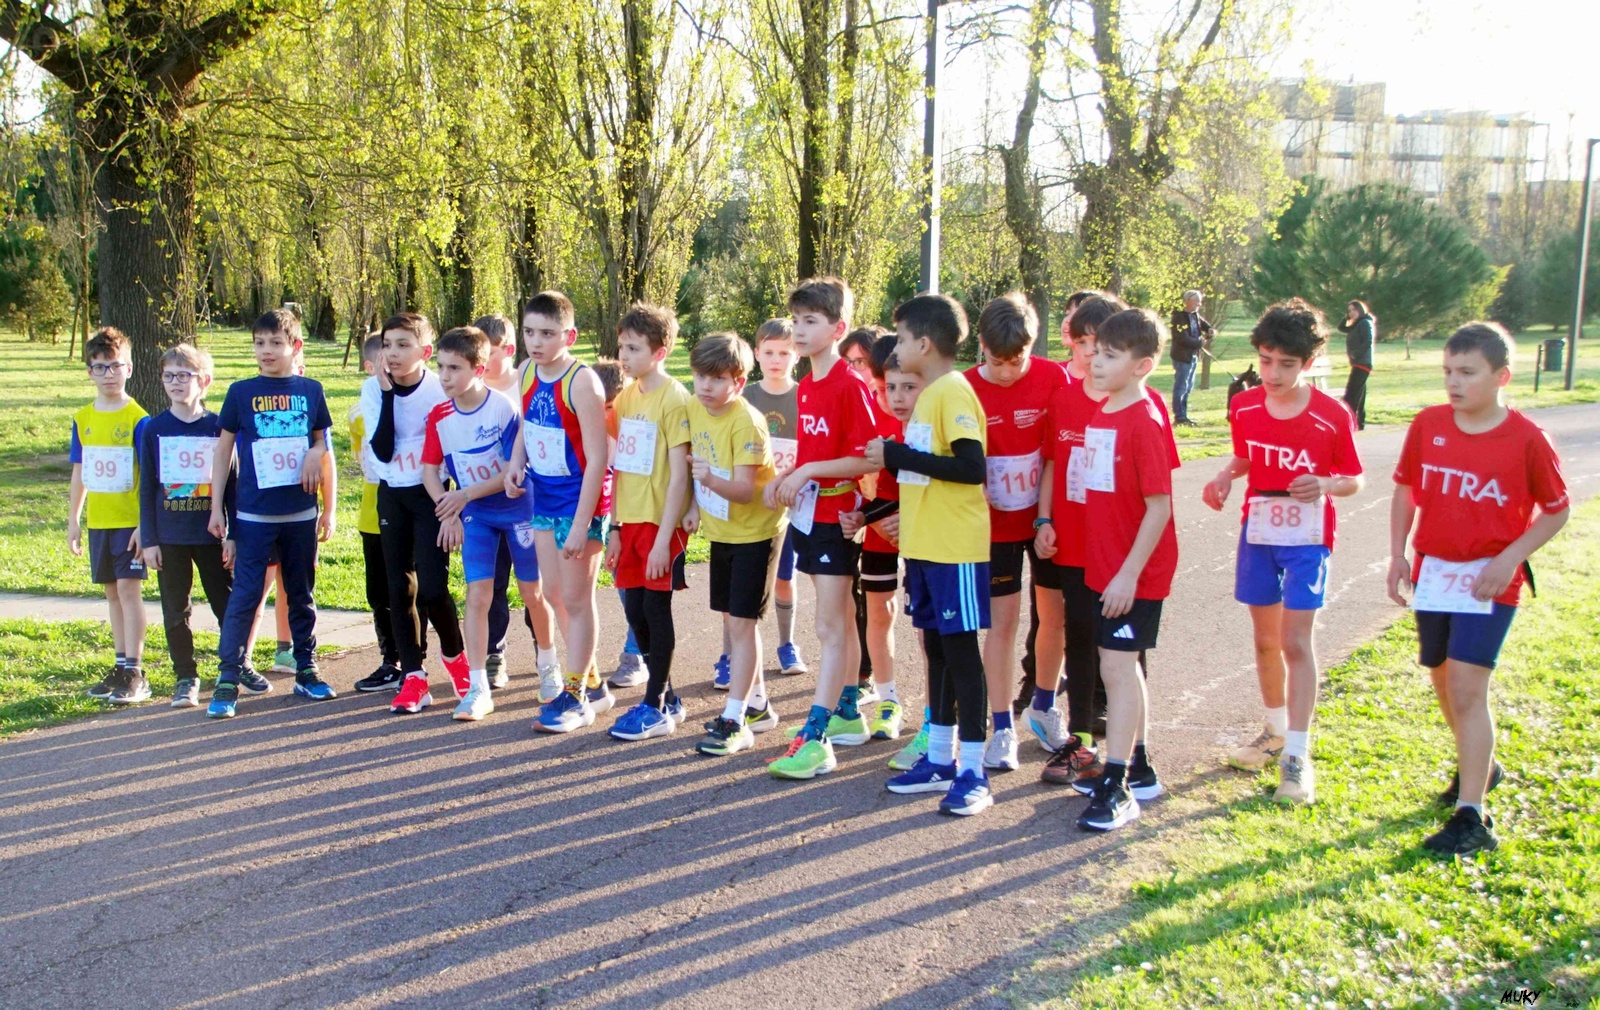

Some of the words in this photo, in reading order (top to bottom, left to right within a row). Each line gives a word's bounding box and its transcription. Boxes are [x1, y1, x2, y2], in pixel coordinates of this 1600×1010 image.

[537, 440, 546, 460] 3
[618, 434, 637, 456] 68
[94, 460, 117, 478] 99
[179, 451, 205, 469] 95
[272, 451, 298, 471] 96
[394, 452, 419, 472] 11
[466, 460, 502, 482] 101
[1001, 467, 1039, 494] 110
[163, 498, 212, 512] POKÉMO
[1270, 505, 1301, 527] 88
[1442, 573, 1475, 593] 79
